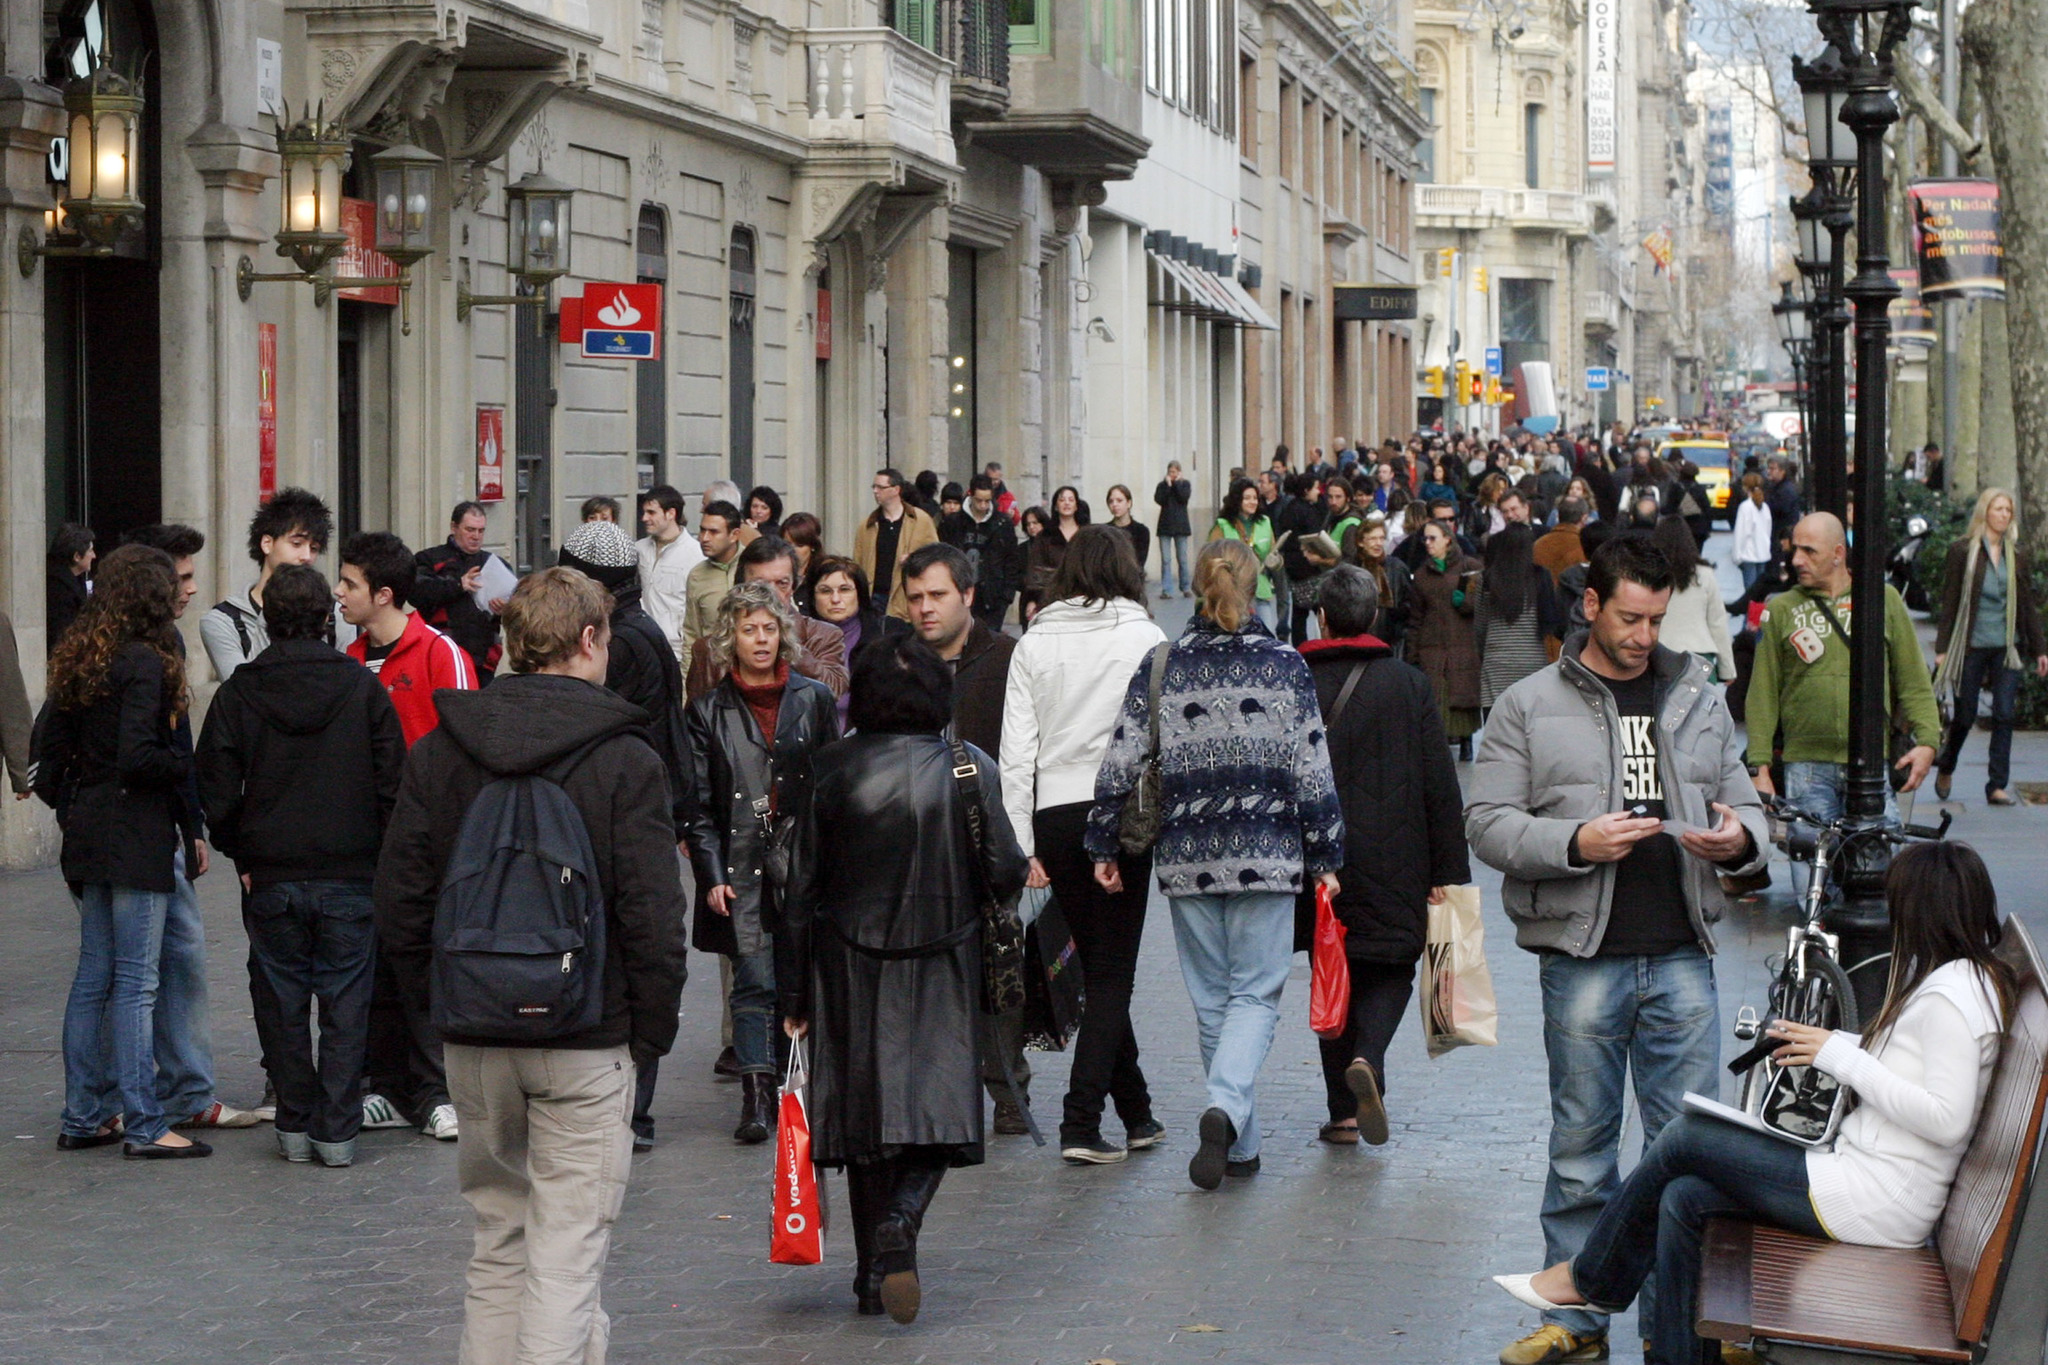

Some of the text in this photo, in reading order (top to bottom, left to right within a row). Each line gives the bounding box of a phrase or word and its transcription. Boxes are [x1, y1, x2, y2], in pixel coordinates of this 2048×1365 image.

[1595, 0, 1609, 72] OGESA
[1591, 143, 1611, 155] 233
[1922, 199, 1945, 213] Per
[1924, 227, 1996, 243] autobusos
